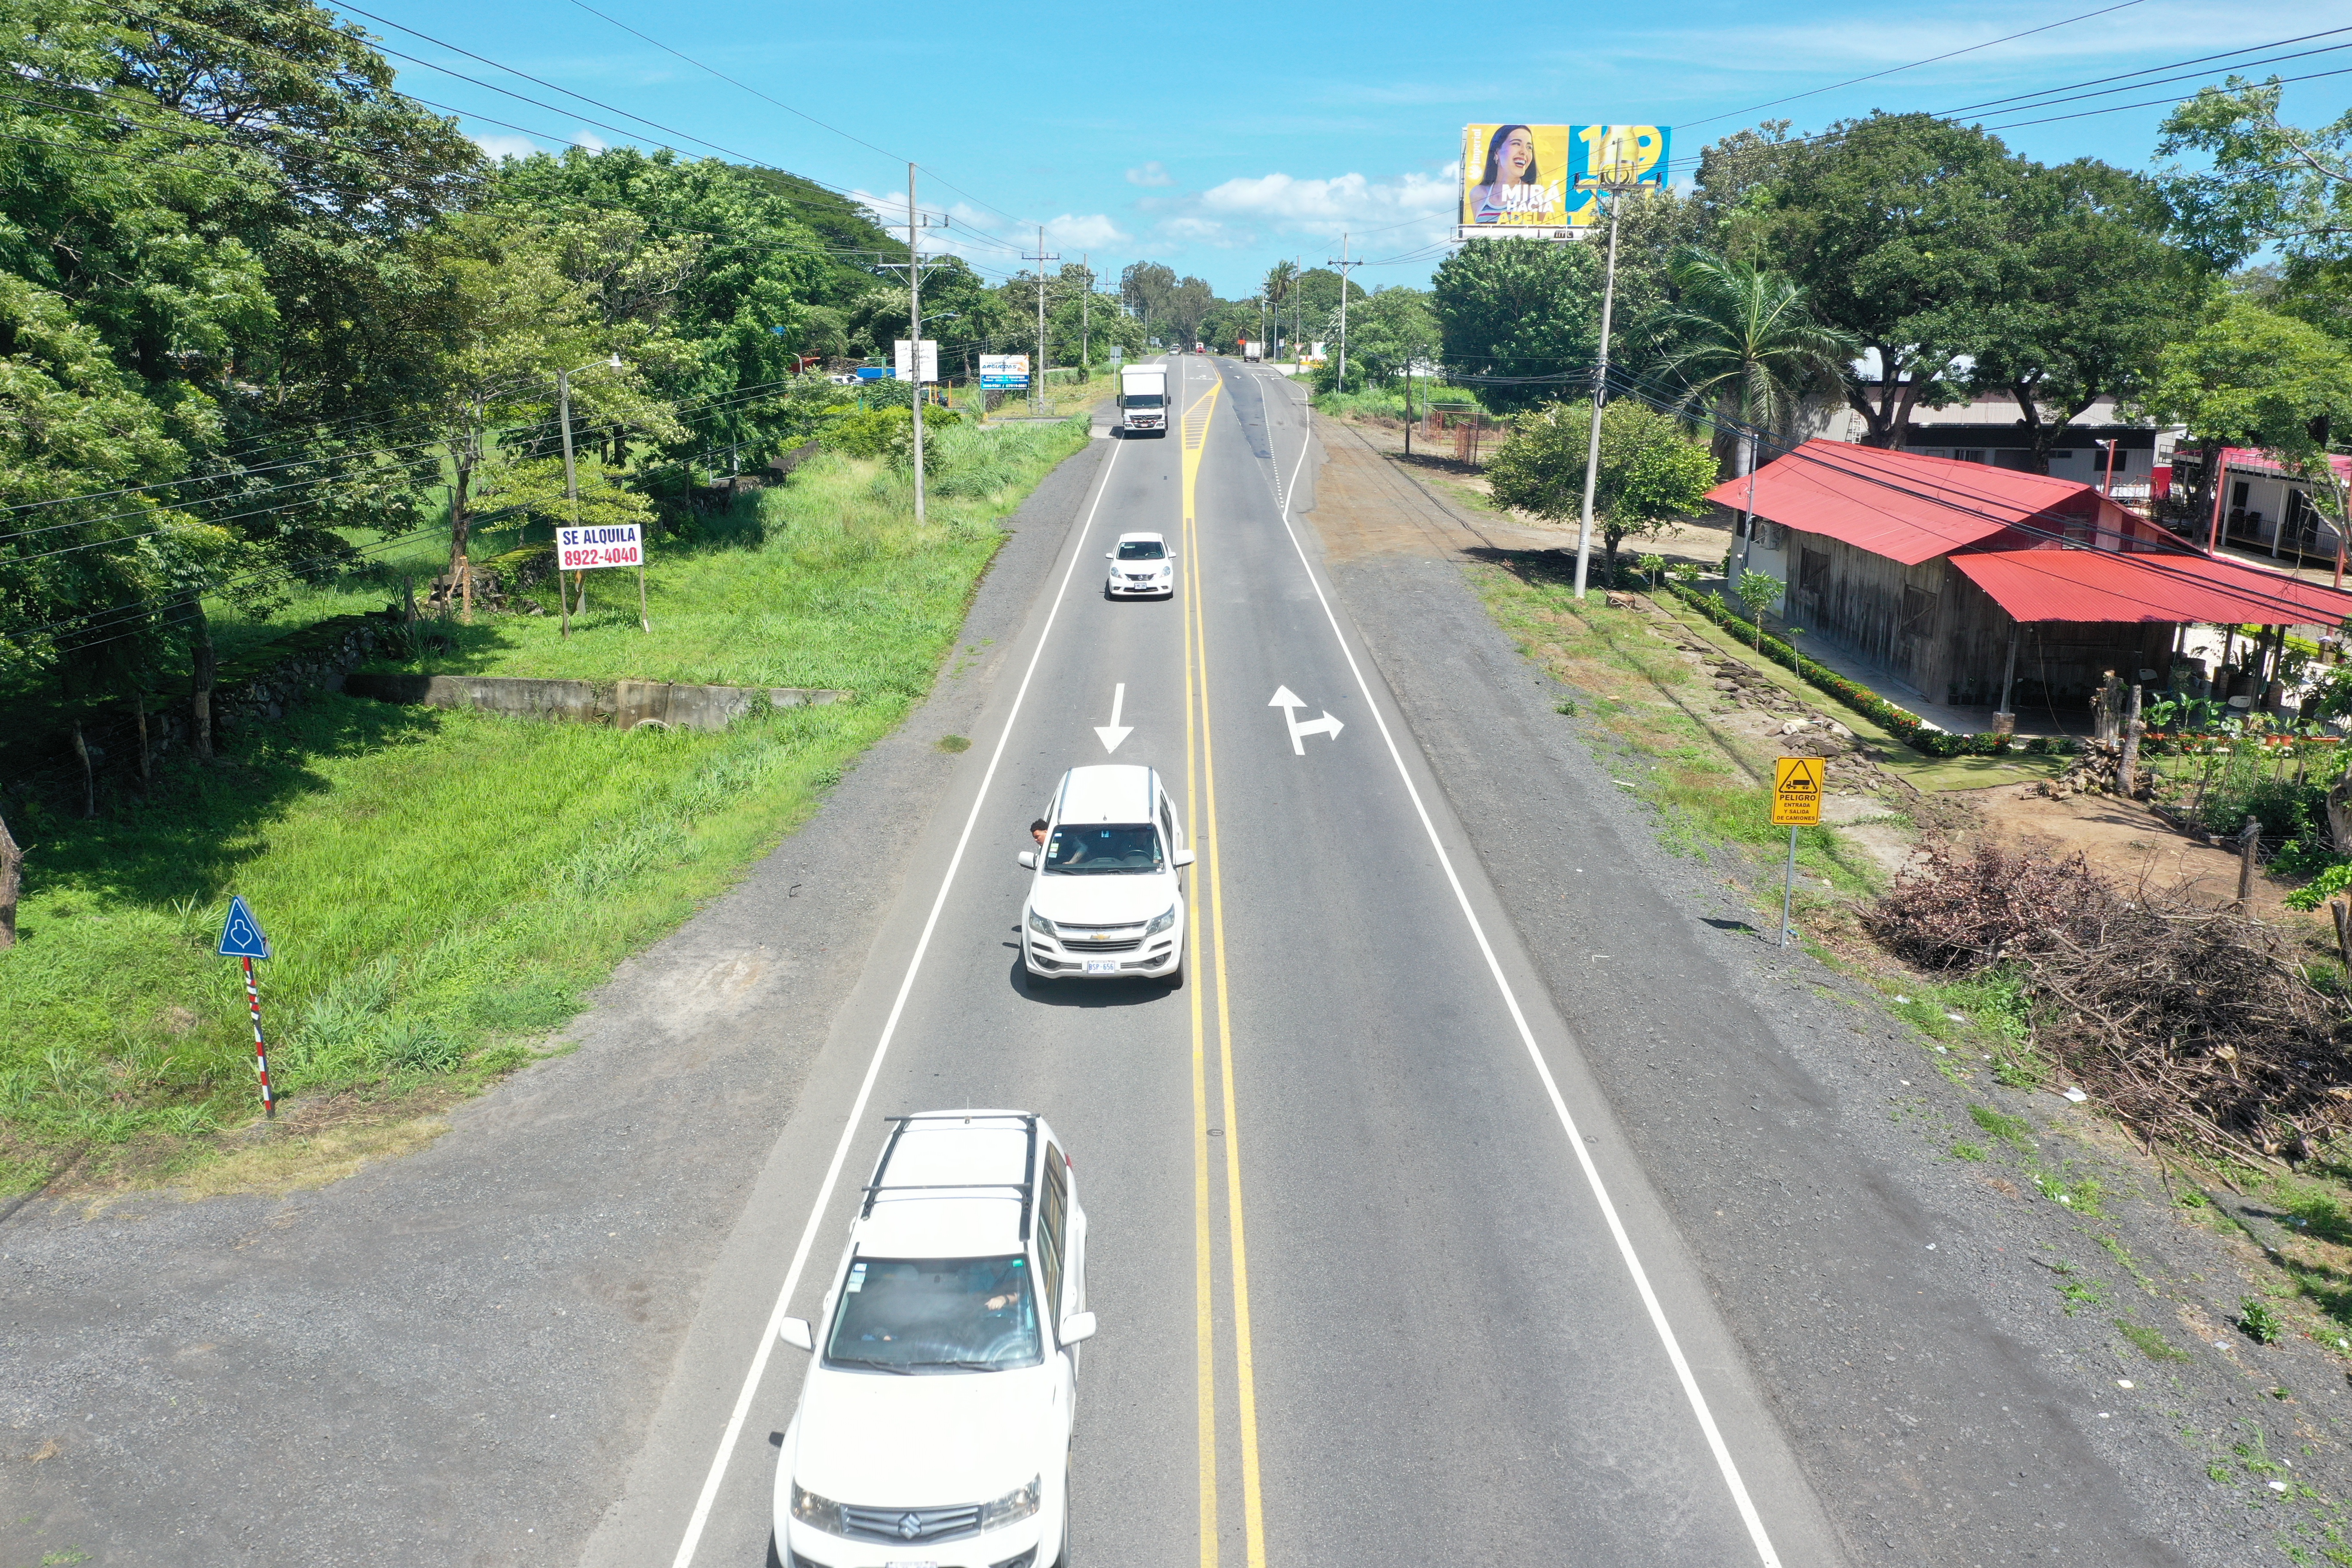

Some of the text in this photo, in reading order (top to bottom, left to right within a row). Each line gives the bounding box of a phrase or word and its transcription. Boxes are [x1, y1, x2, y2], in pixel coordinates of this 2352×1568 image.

[1470, 128, 1482, 163] Imperial
[1501, 180, 1561, 203] MIRÁ
[1507, 200, 1555, 212] HACIA
[563, 528, 636, 545] SE ALQUILA
[564, 547, 637, 566] 8922-4040
